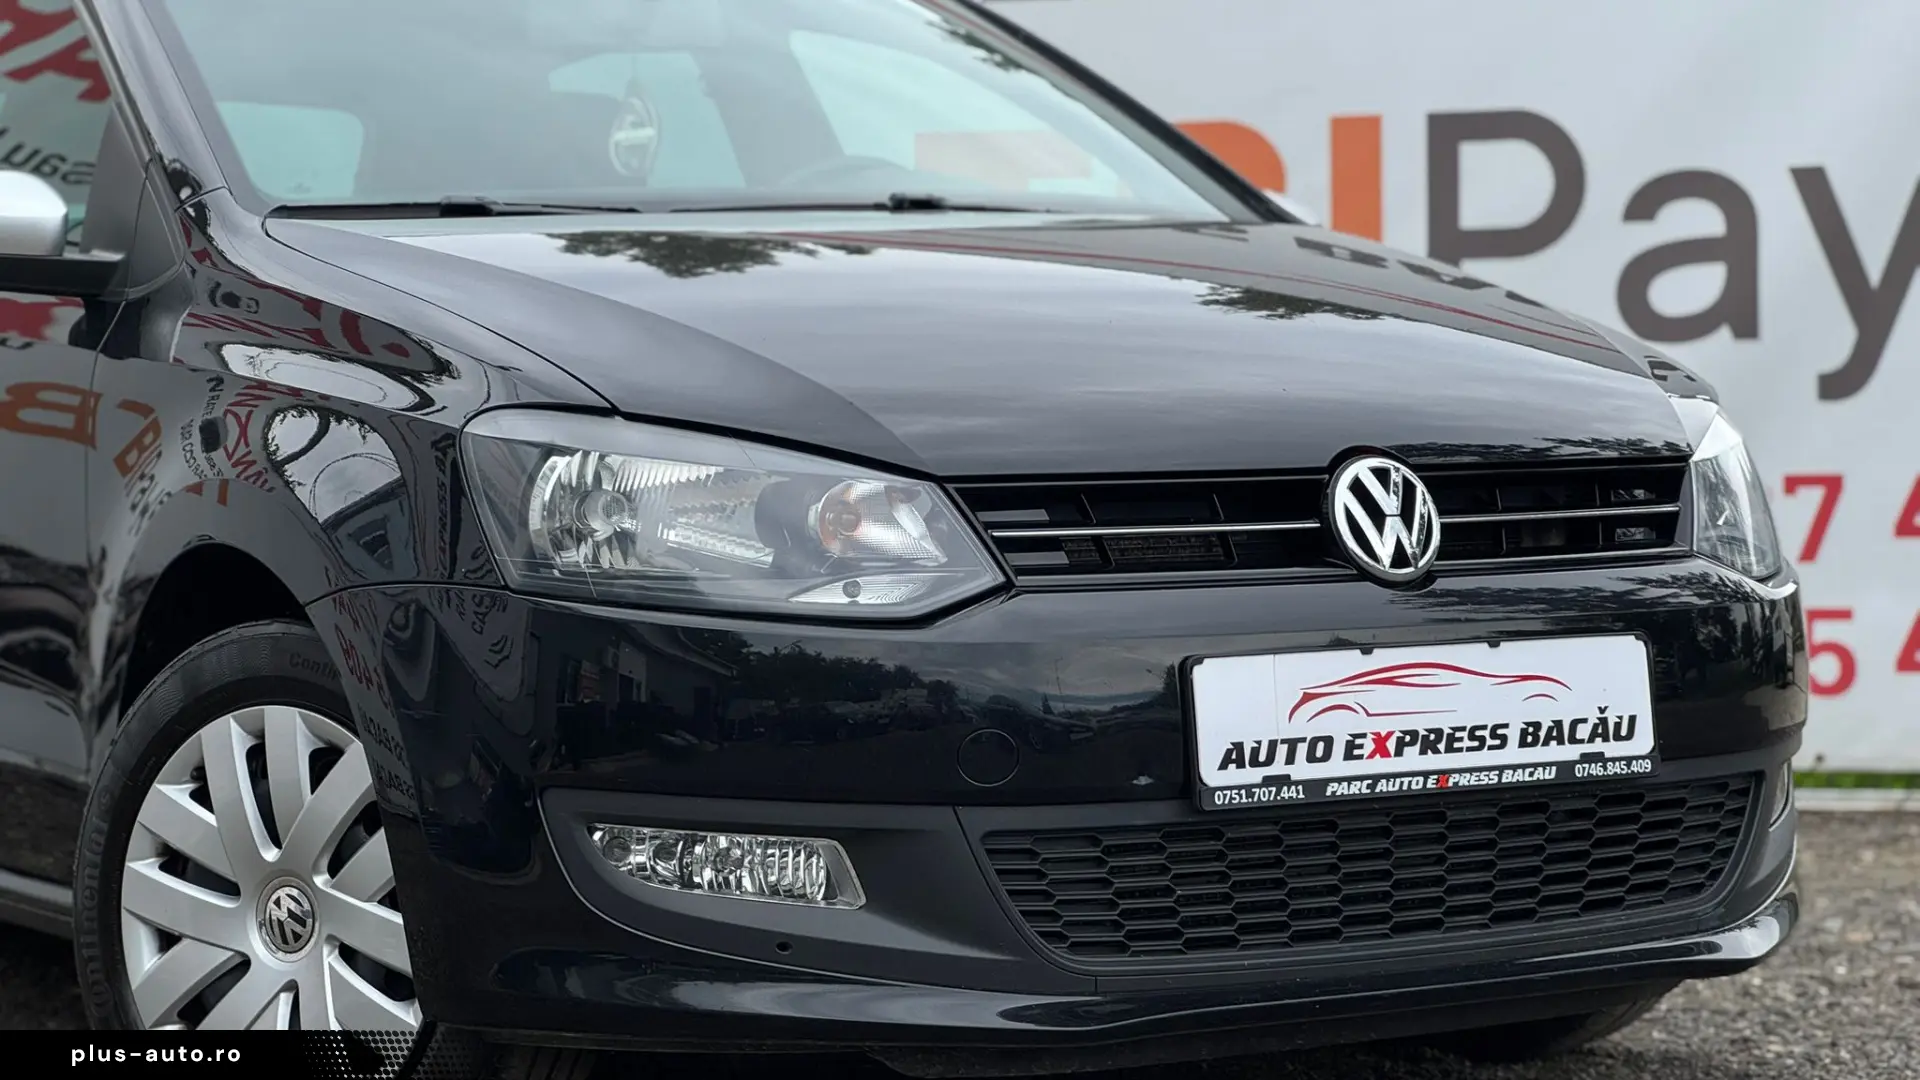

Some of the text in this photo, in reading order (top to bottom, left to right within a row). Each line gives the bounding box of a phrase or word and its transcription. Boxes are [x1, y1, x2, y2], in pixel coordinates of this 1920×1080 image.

[1216, 705, 1638, 771] AUTO EXPRESS BACĂU
[1214, 758, 1652, 805] 0751.707.441 PARC AUTO EXPRESS BACAU 0746.845.409
